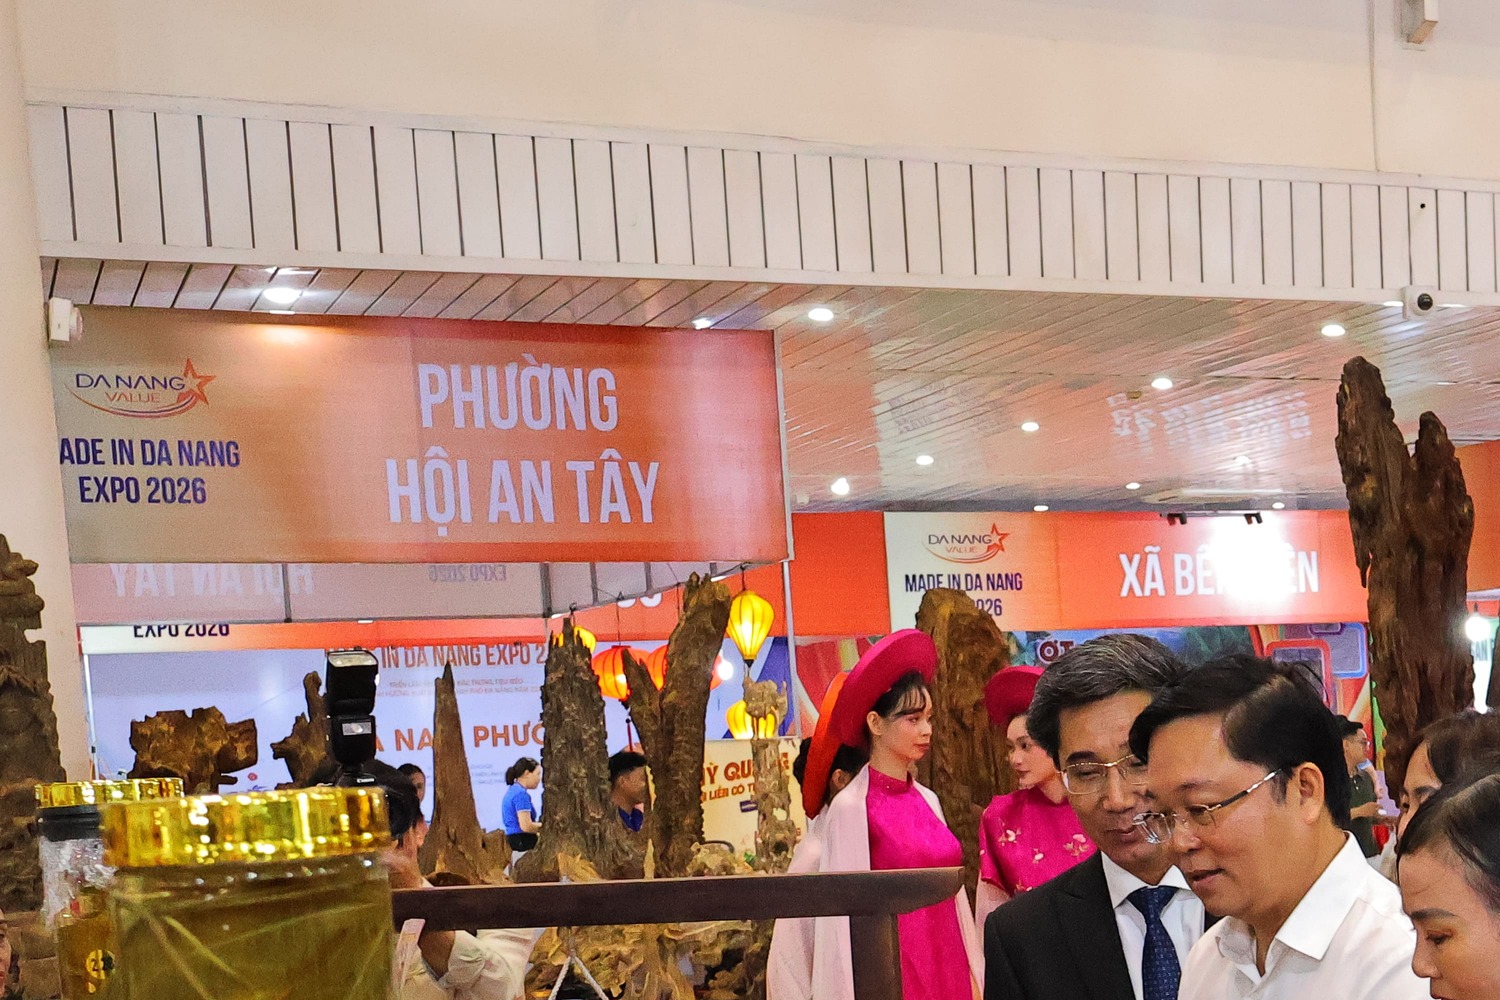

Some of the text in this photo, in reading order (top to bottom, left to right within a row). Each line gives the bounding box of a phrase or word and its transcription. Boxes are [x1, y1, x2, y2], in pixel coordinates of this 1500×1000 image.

[75, 373, 186, 391] DA NANG
[418, 353, 619, 432] PHƯỜNG
[104, 391, 161, 403] VALUE
[60, 438, 241, 468] ADE IN DA NANG
[78, 476, 207, 505] EXPO 2026
[385, 445, 660, 537] HỘI AN TÂY
[928, 534, 992, 545] DA NANG
[905, 572, 1023, 592] MADE IN DA NANG
[1119, 545, 1166, 597] XÃ
[382, 646, 400, 669] IN
[404, 645, 430, 669] DA
[433, 643, 481, 669] NANG
[485, 643, 531, 667] EXPO
